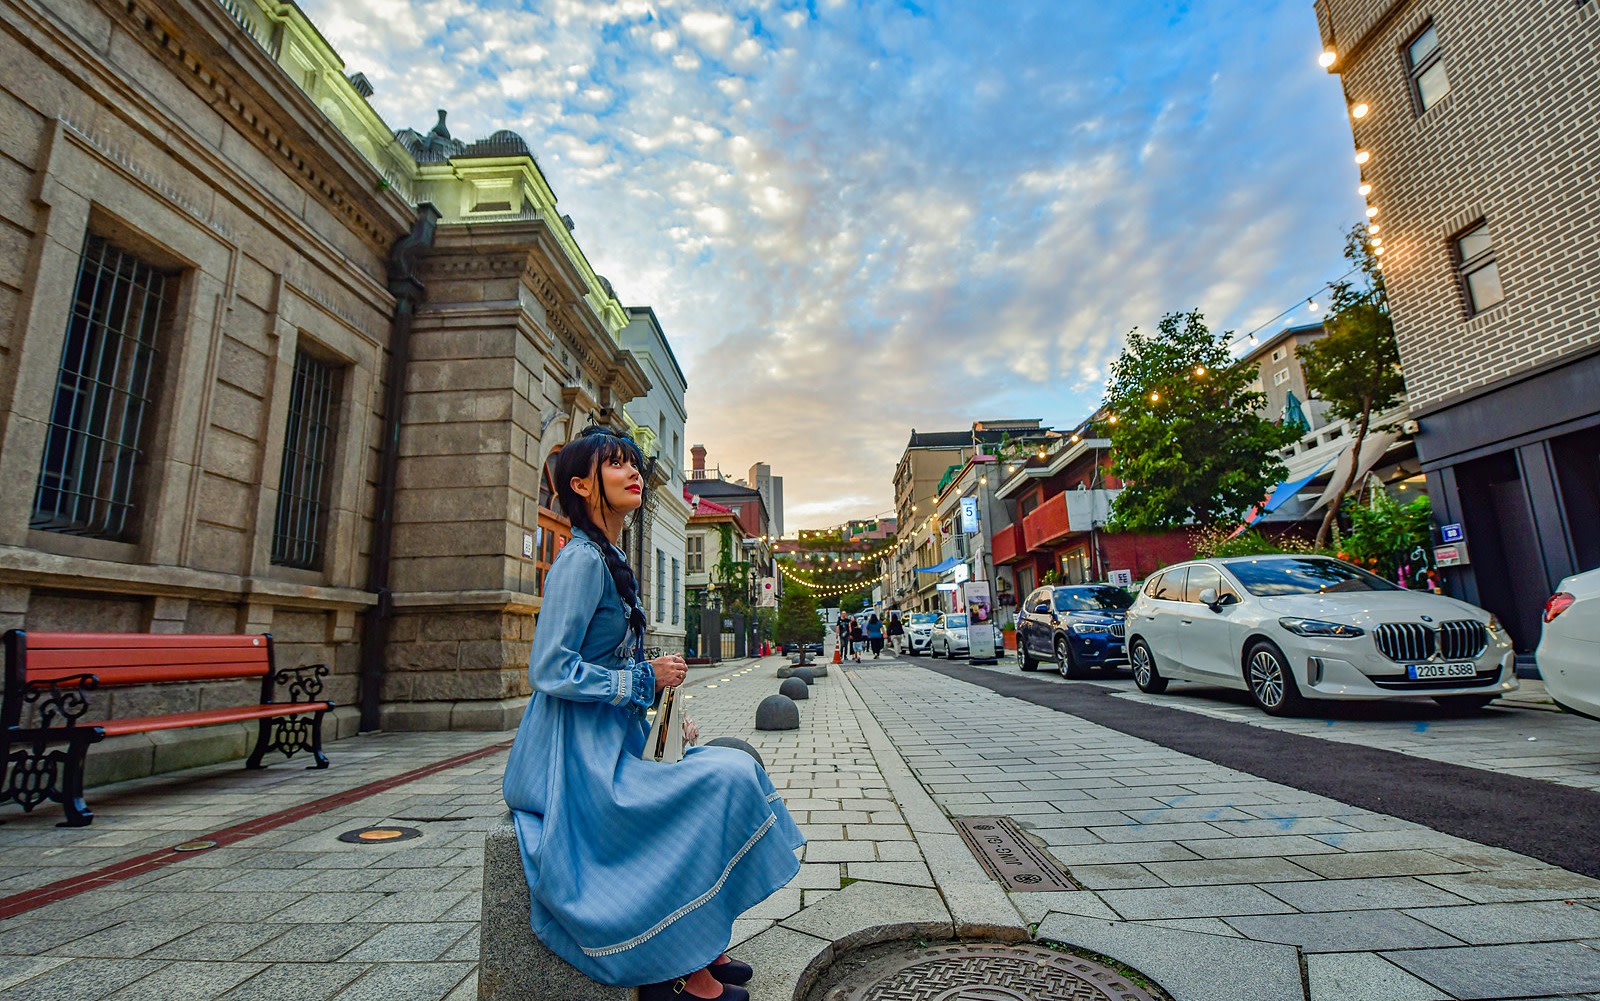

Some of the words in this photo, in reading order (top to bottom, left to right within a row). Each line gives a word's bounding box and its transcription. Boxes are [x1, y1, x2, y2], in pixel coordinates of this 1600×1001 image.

[966, 506, 973, 517] 5
[1448, 664, 1473, 676] 6388
[983, 835, 1023, 866] JUNG-GU
